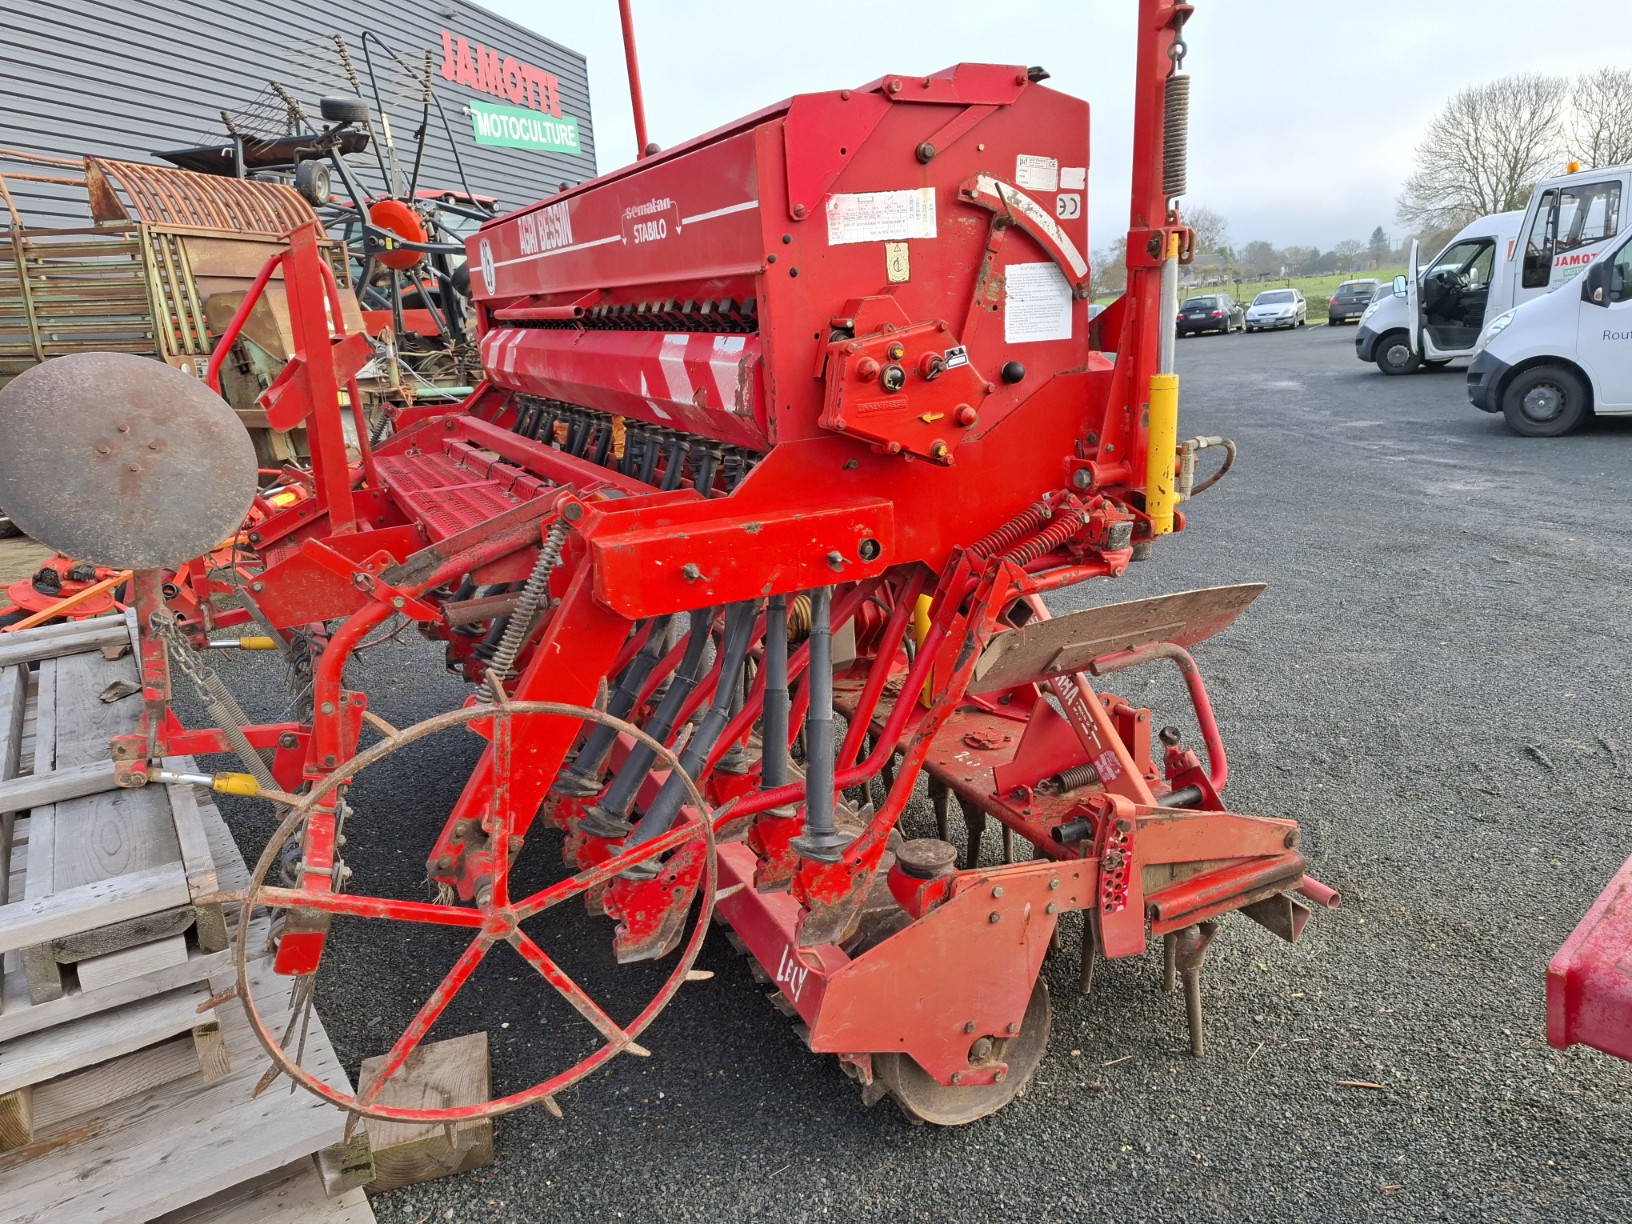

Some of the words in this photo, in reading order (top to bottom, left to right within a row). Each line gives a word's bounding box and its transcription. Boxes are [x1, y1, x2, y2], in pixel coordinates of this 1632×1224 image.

[441, 31, 563, 118] JAMOTTE
[477, 112, 577, 147] MOTOCULTURE
[518, 214, 539, 256] AGRI
[538, 201, 573, 251] BESSIN
[633, 219, 667, 243] STABILO
[777, 943, 809, 1004] LELY
